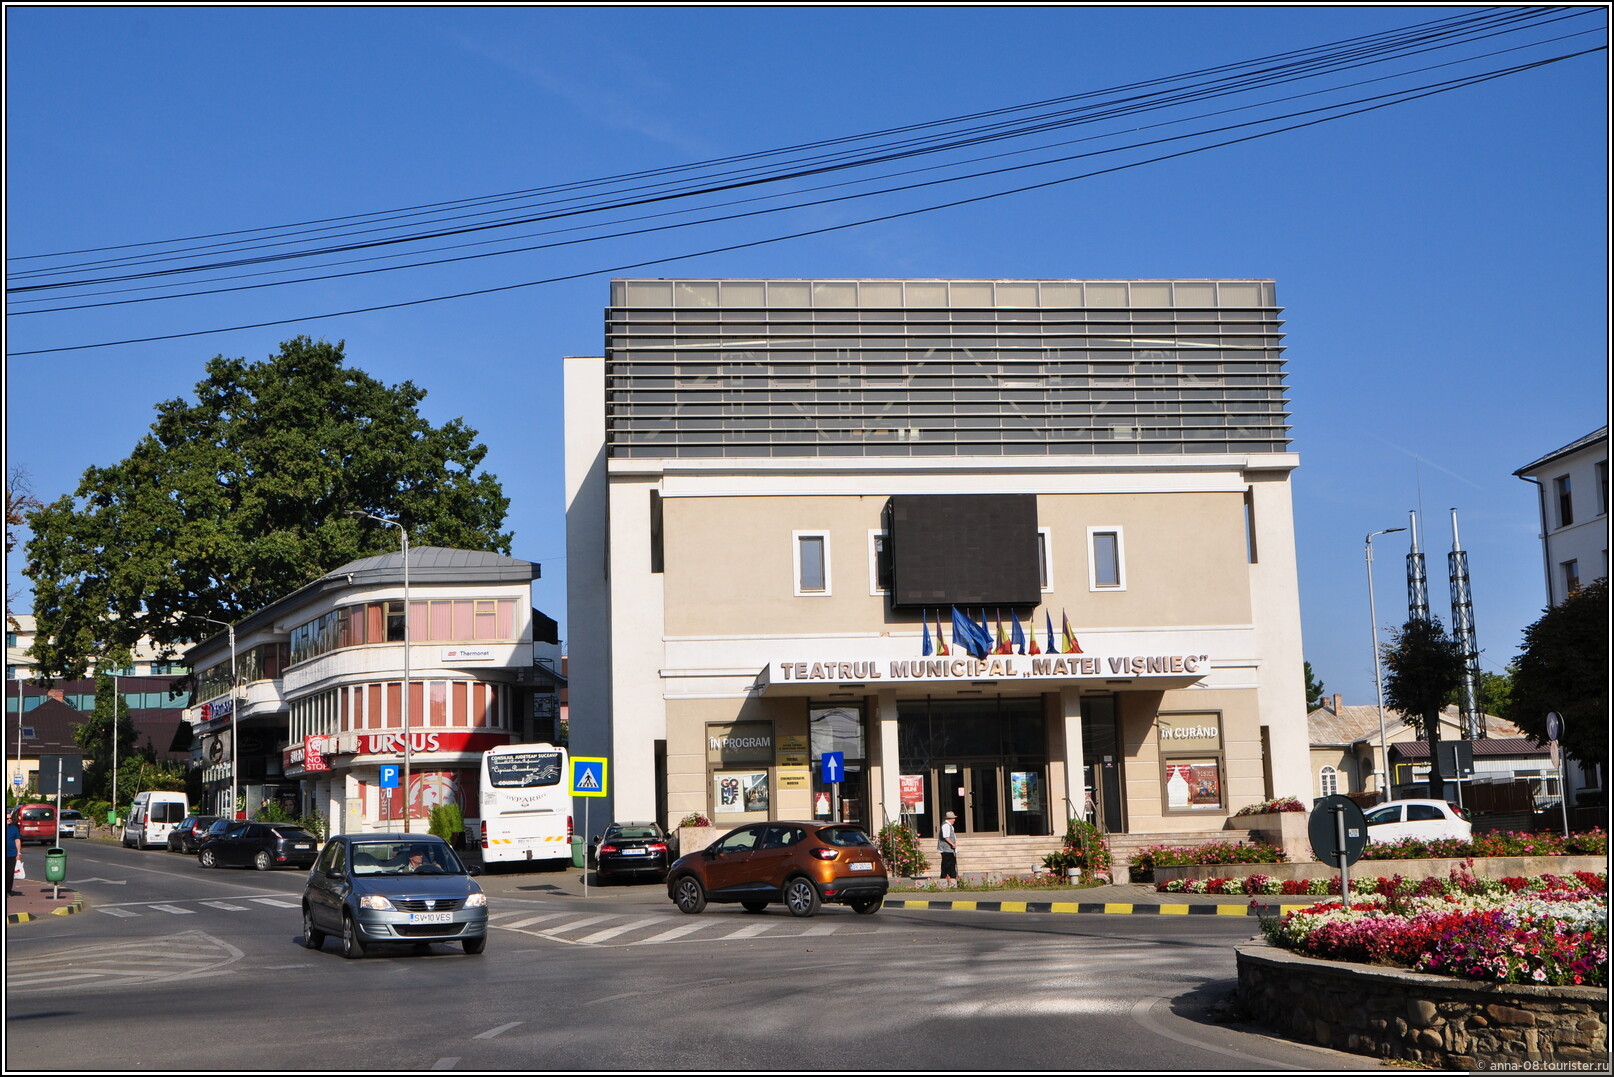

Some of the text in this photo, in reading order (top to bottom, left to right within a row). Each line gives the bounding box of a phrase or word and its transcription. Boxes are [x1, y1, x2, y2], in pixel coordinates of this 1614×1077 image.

[780, 662, 882, 680] TEATRUL
[889, 658, 1018, 679] MUNICIPAL
[1160, 724, 1219, 739] ÎN CURÂND
[368, 732, 441, 757] URSUS
[708, 736, 720, 749] ÎN
[722, 736, 771, 748] PROGRAM
[384, 768, 395, 782] P
[720, 778, 739, 788] GO
[414, 914, 425, 922] SV
[435, 913, 451, 921] VES
